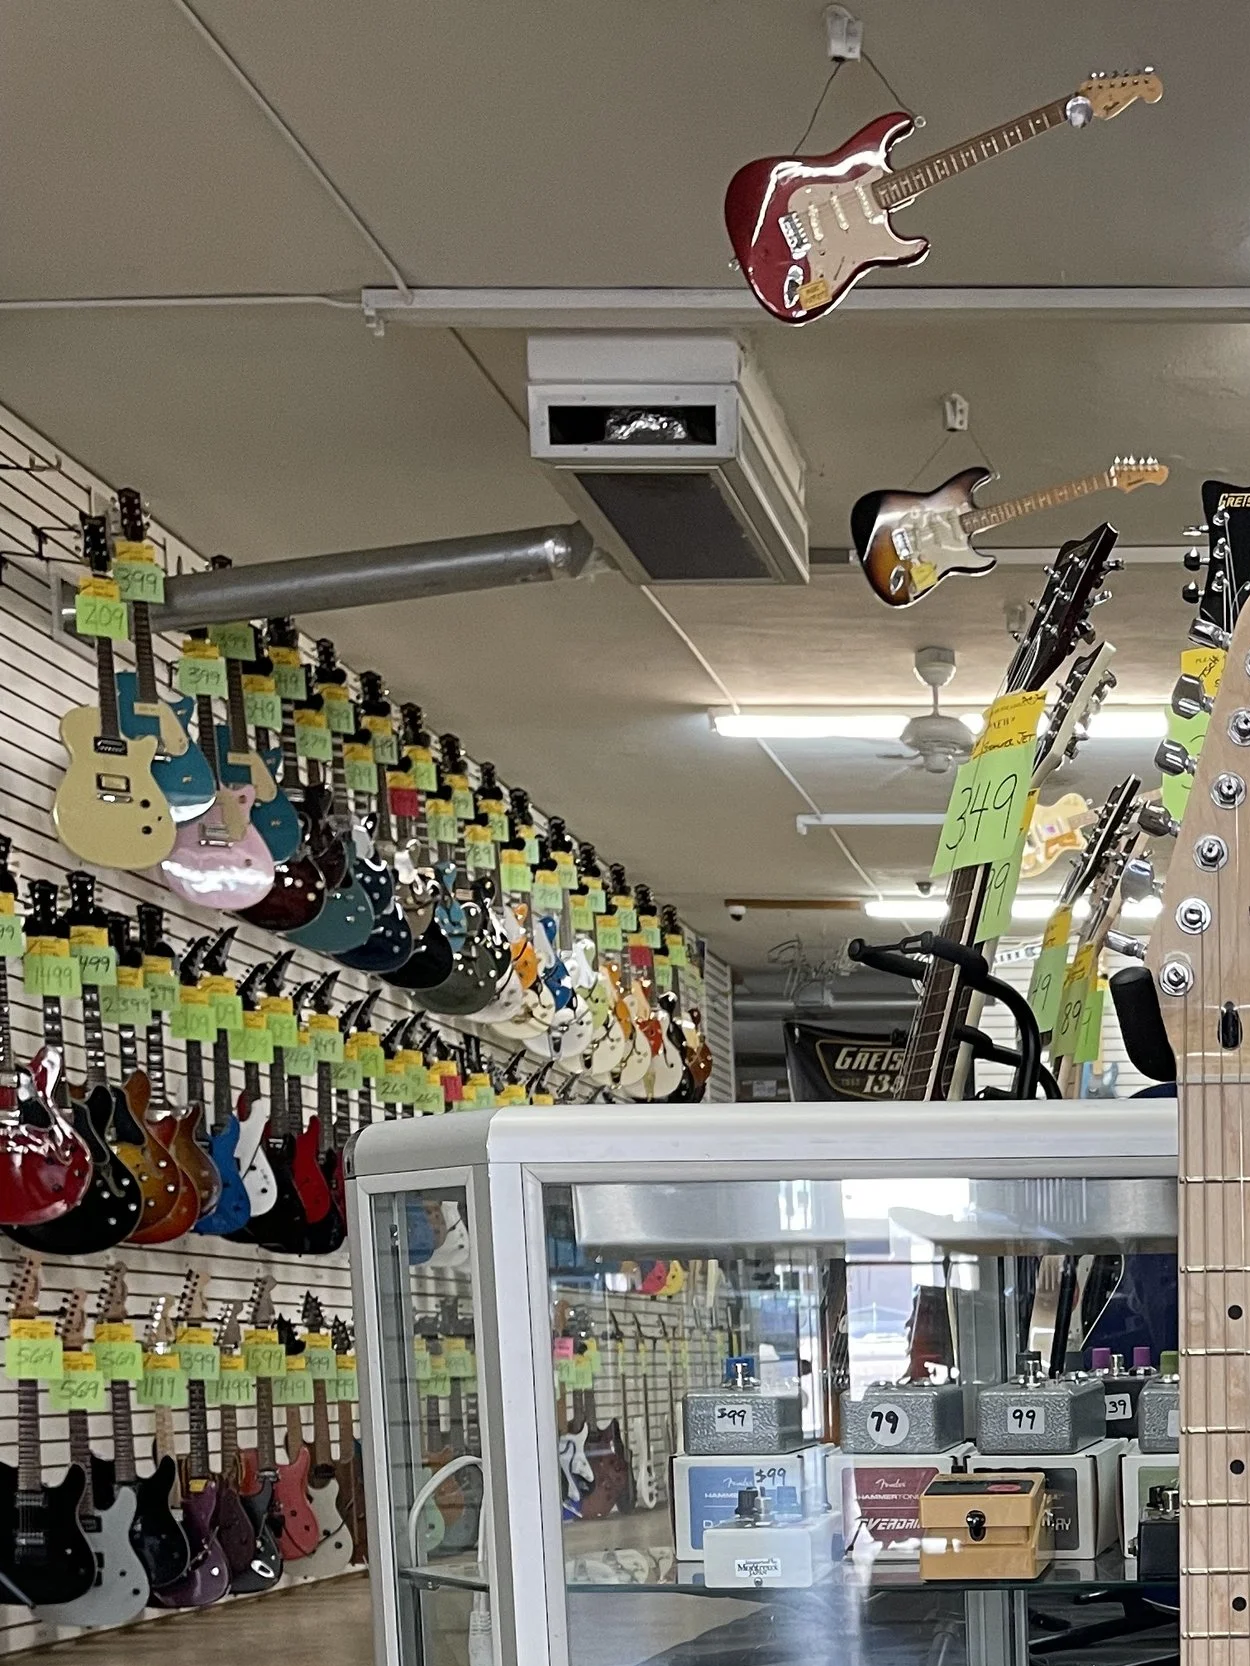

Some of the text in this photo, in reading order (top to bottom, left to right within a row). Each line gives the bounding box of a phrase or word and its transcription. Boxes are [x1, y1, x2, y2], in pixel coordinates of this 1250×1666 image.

[946, 774, 1018, 851] 349
[34, 966, 74, 993] 1499
[835, 1047, 905, 1070] GRETS
[717, 1407, 747, 1427] $99
[870, 1411, 899, 1434] 79
[1012, 1409, 1037, 1430] 99
[755, 1467, 787, 1487] $99
[875, 1478, 907, 1489] Fender
